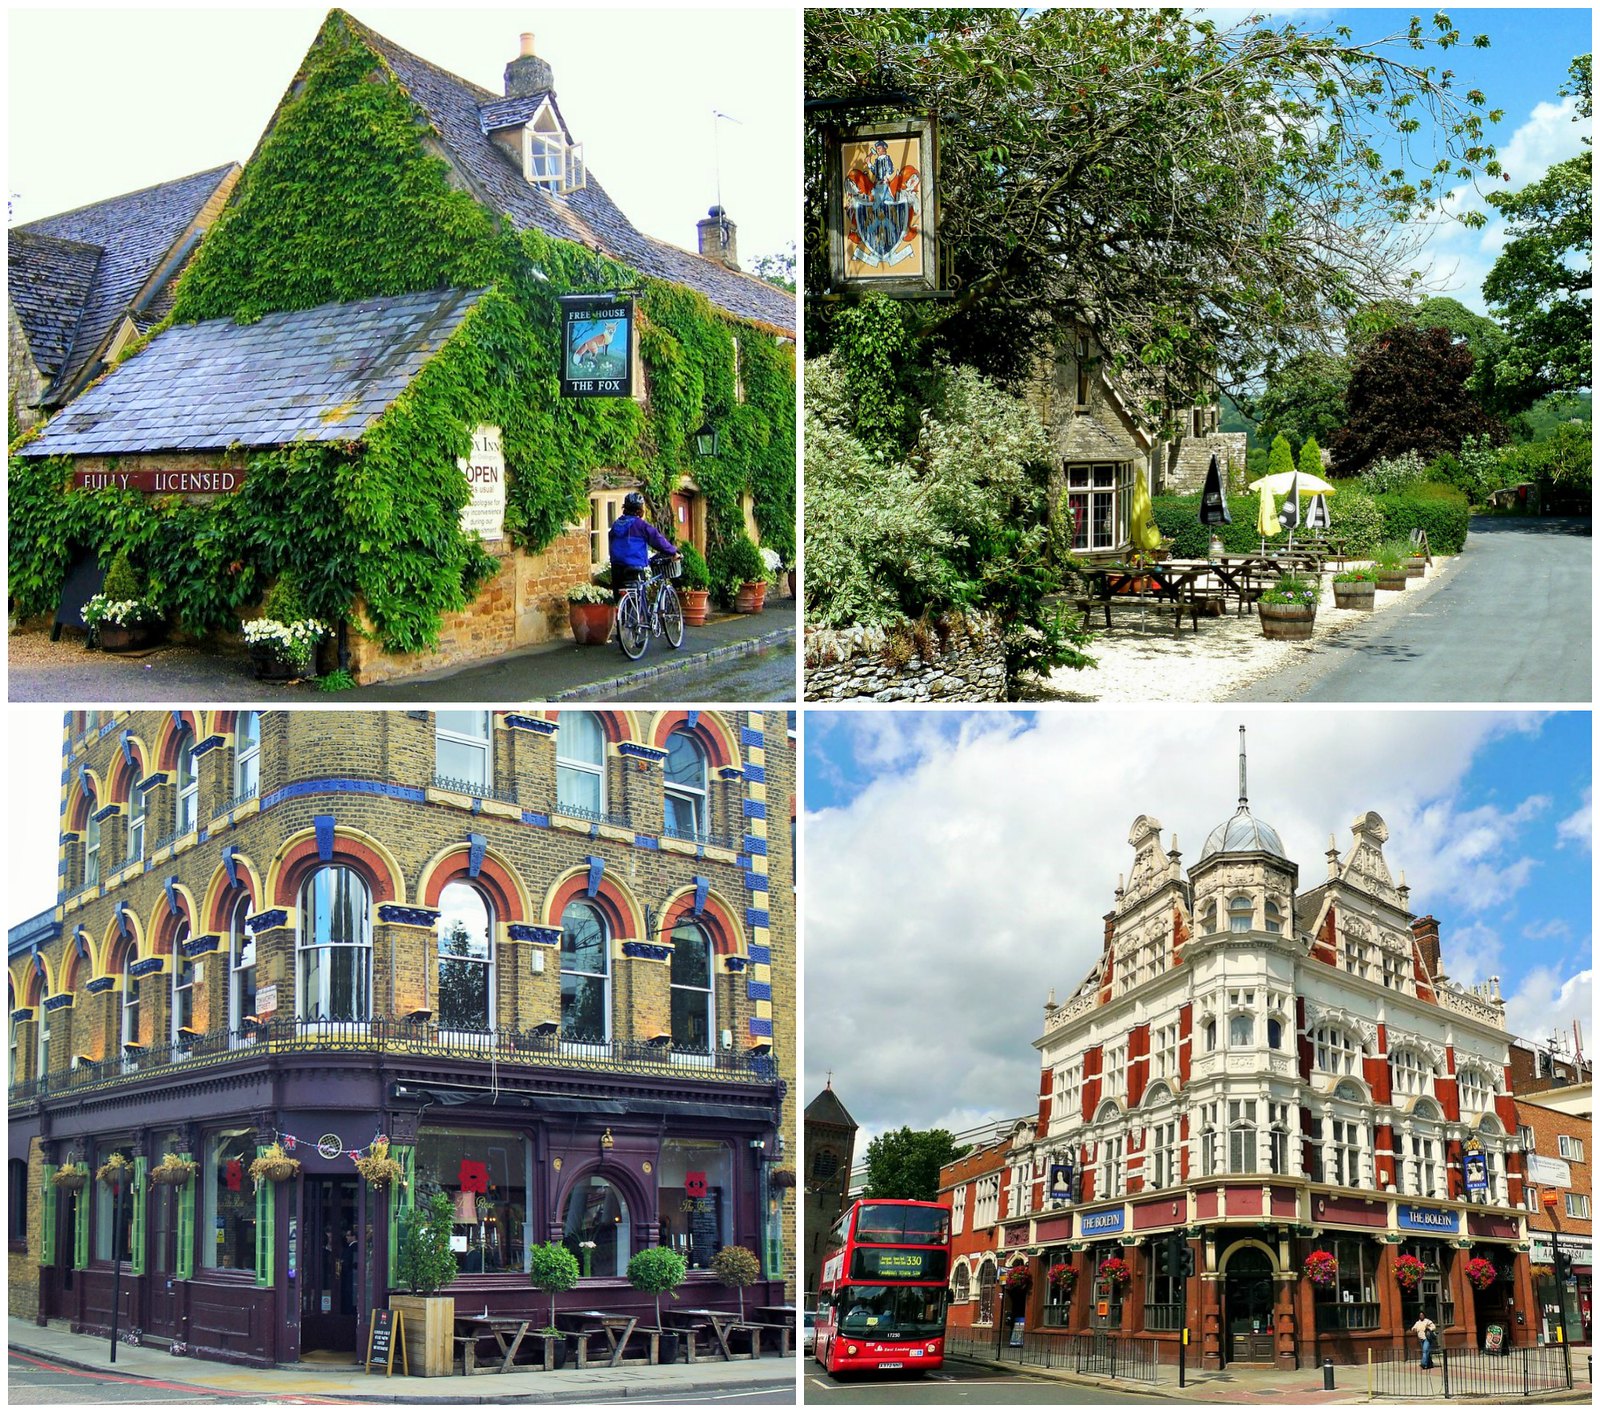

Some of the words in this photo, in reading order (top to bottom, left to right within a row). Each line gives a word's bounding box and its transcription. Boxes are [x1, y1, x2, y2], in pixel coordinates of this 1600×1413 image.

[569, 311, 591, 320] FREE
[596, 309, 626, 318] HOUSE
[572, 381, 593, 391] THE
[598, 380, 620, 391] FOX
[155, 472, 235, 490] LICENSED
[465, 465, 498, 483] OPEN
[1083, 1217, 1095, 1229] THE
[1096, 1214, 1120, 1228] BOLEYN
[1409, 1211, 1424, 1223] THE
[1424, 1213, 1452, 1226] BOLEYN
[907, 1256, 922, 1266] 330
